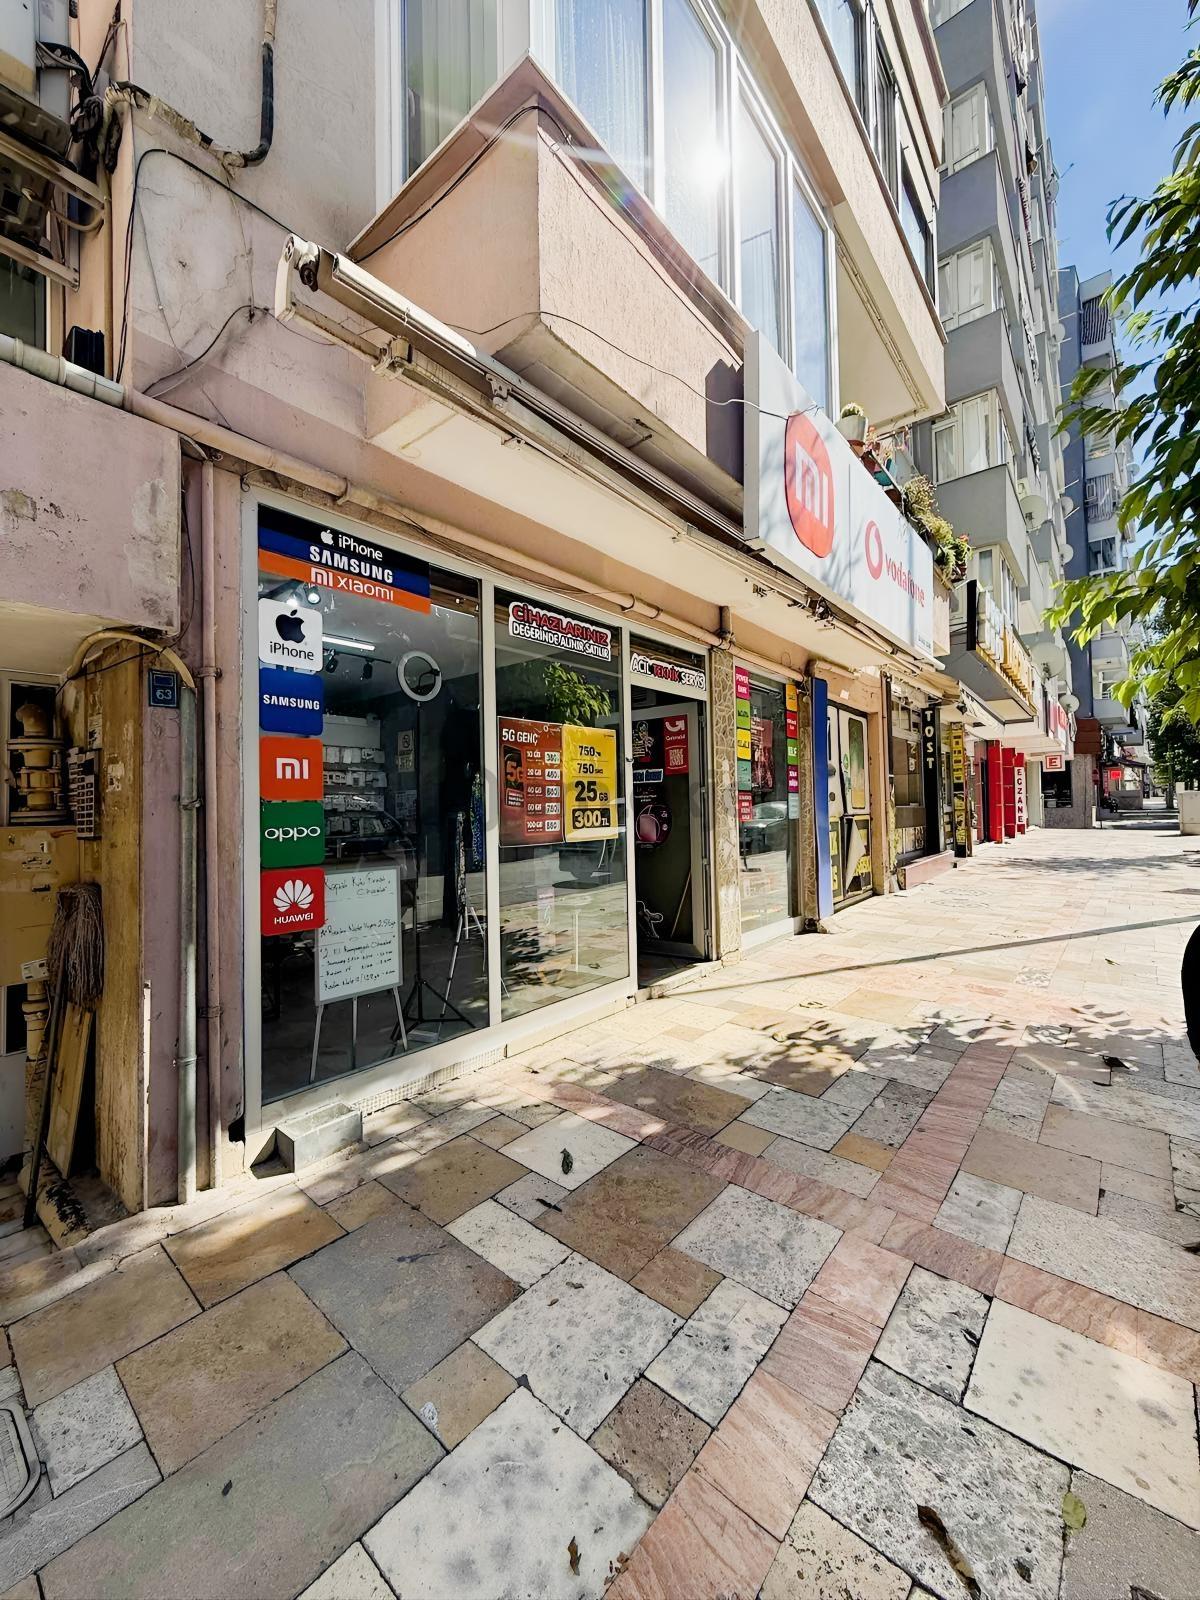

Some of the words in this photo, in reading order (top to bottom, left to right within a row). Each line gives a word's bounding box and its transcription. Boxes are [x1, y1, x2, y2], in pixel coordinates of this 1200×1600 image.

[339, 534, 383, 561] iPhone
[310, 545, 393, 583] SAMSUNG
[885, 554, 925, 607] vodafone
[269, 641, 314, 661] iPhone
[155, 688, 172, 700] 63
[263, 694, 320, 711] SAMSUNG
[502, 728, 515, 742] 5G
[517, 731, 538, 746] GENÇ
[924, 710, 934, 769] TOST
[578, 745, 595, 757] 750
[577, 763, 594, 774] 750
[1048, 757, 1059, 767] E
[574, 780, 597, 802] 25
[1016, 768, 1024, 823] ECZANE
[574, 811, 602, 828] 300
[264, 825, 321, 840] oppo
[274, 912, 314, 925] HUAWEI
